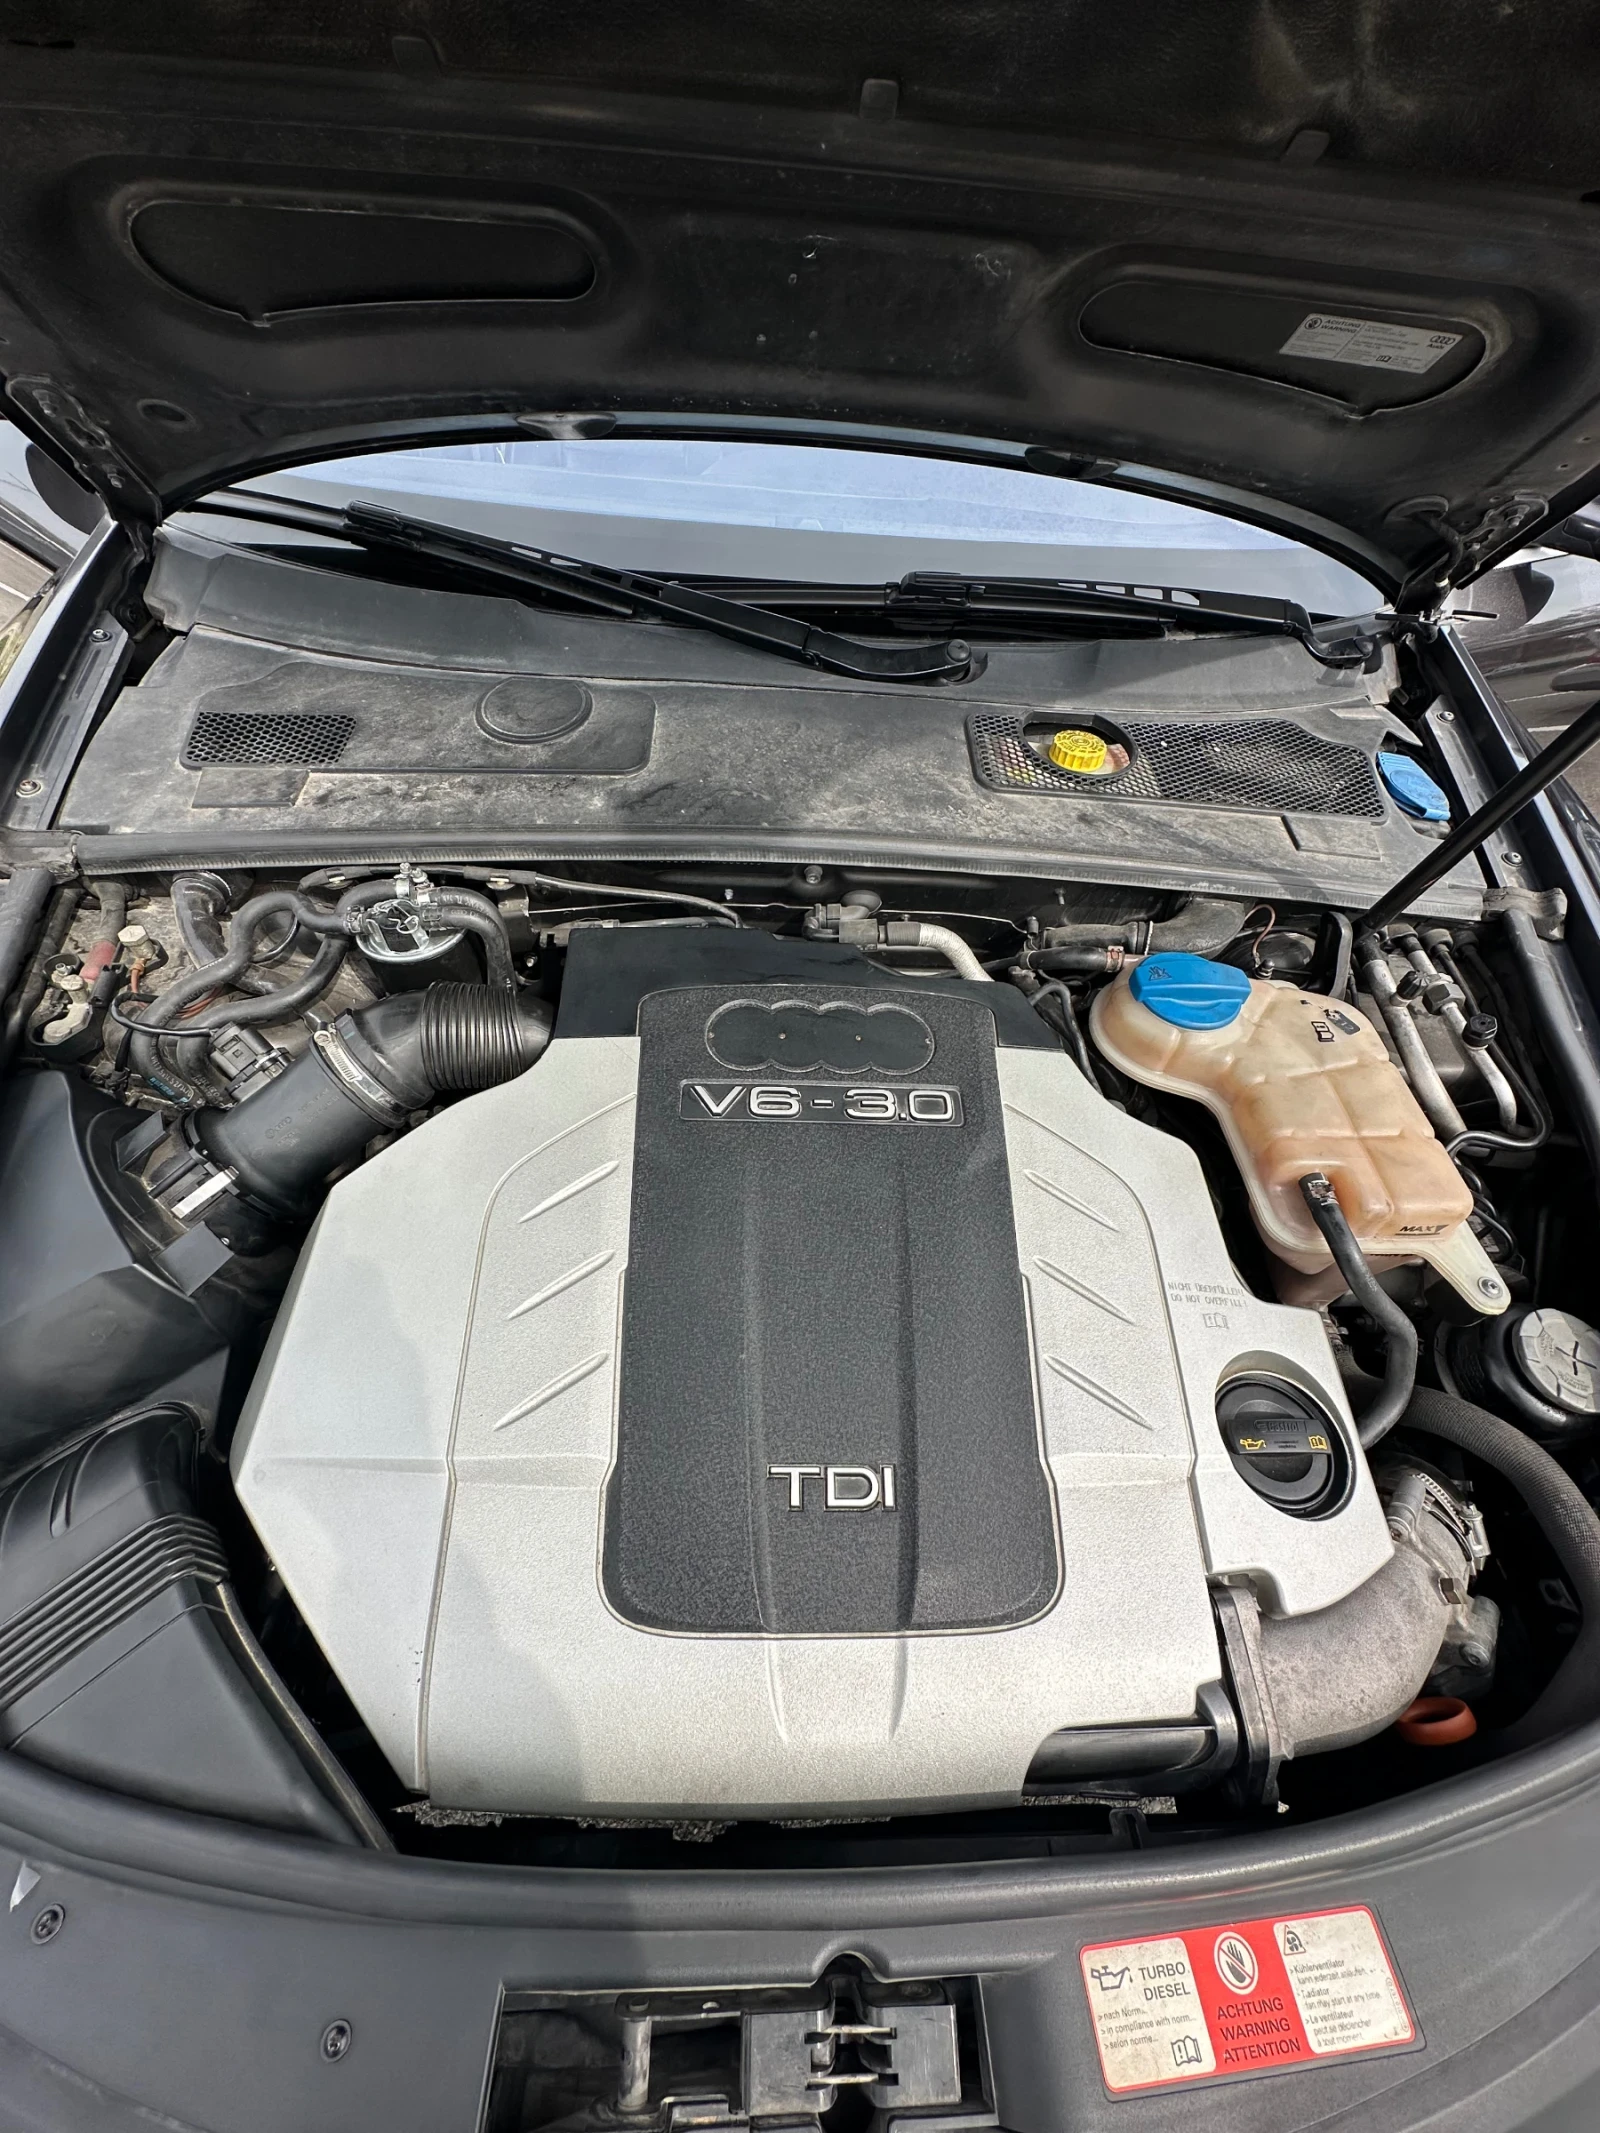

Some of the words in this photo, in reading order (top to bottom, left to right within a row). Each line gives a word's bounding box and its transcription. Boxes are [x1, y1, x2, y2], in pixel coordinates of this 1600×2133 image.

[1321, 324, 1357, 333] WARNING
[1323, 319, 1361, 328] ACHTUNG
[1167, 1281, 1192, 1292] NICHT
[1170, 1293, 1182, 1302] DO
[1185, 1294, 1201, 1304] NOT
[766, 1463, 896, 1512] TDI
[1138, 1961, 1186, 1981] TURBO
[1143, 1982, 1191, 2001] DIESEL
[1103, 2009, 1121, 2020] nach
[1217, 1996, 1284, 2021] ACHTUNG
[1106, 2024, 1114, 2036] in
[1115, 2020, 1155, 2034] compliance
[1156, 2015, 1171, 2027] with
[1309, 2014, 1319, 2025] Le
[1219, 2017, 1291, 2042] WARNING
[1109, 2037, 1129, 2050] selon
[1224, 2037, 1301, 2064] ATTENTION
